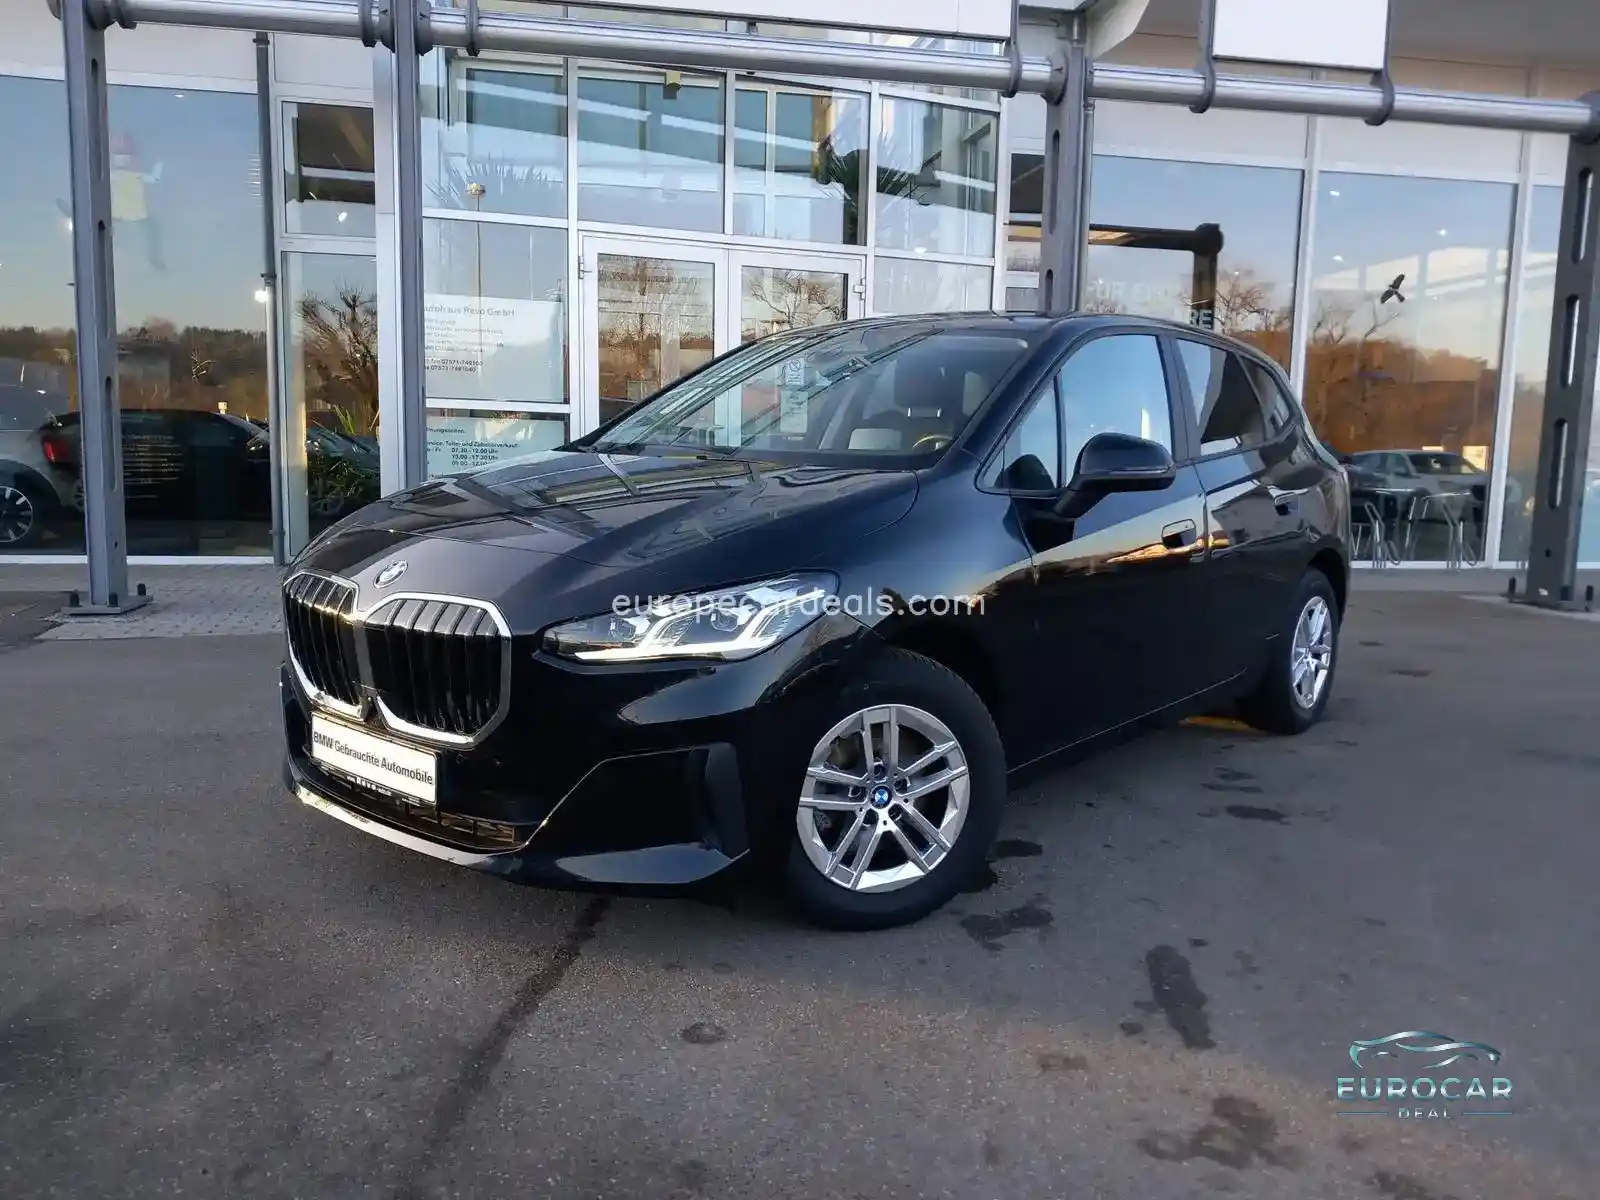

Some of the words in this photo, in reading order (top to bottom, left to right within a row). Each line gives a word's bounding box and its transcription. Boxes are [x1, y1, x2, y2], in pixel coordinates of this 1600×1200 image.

[424, 304, 462, 314] utohaus
[487, 308, 515, 316] GmbH
[313, 731, 335, 749] BMW
[334, 740, 380, 767] Gebrauchte
[381, 757, 433, 785] Automobile
